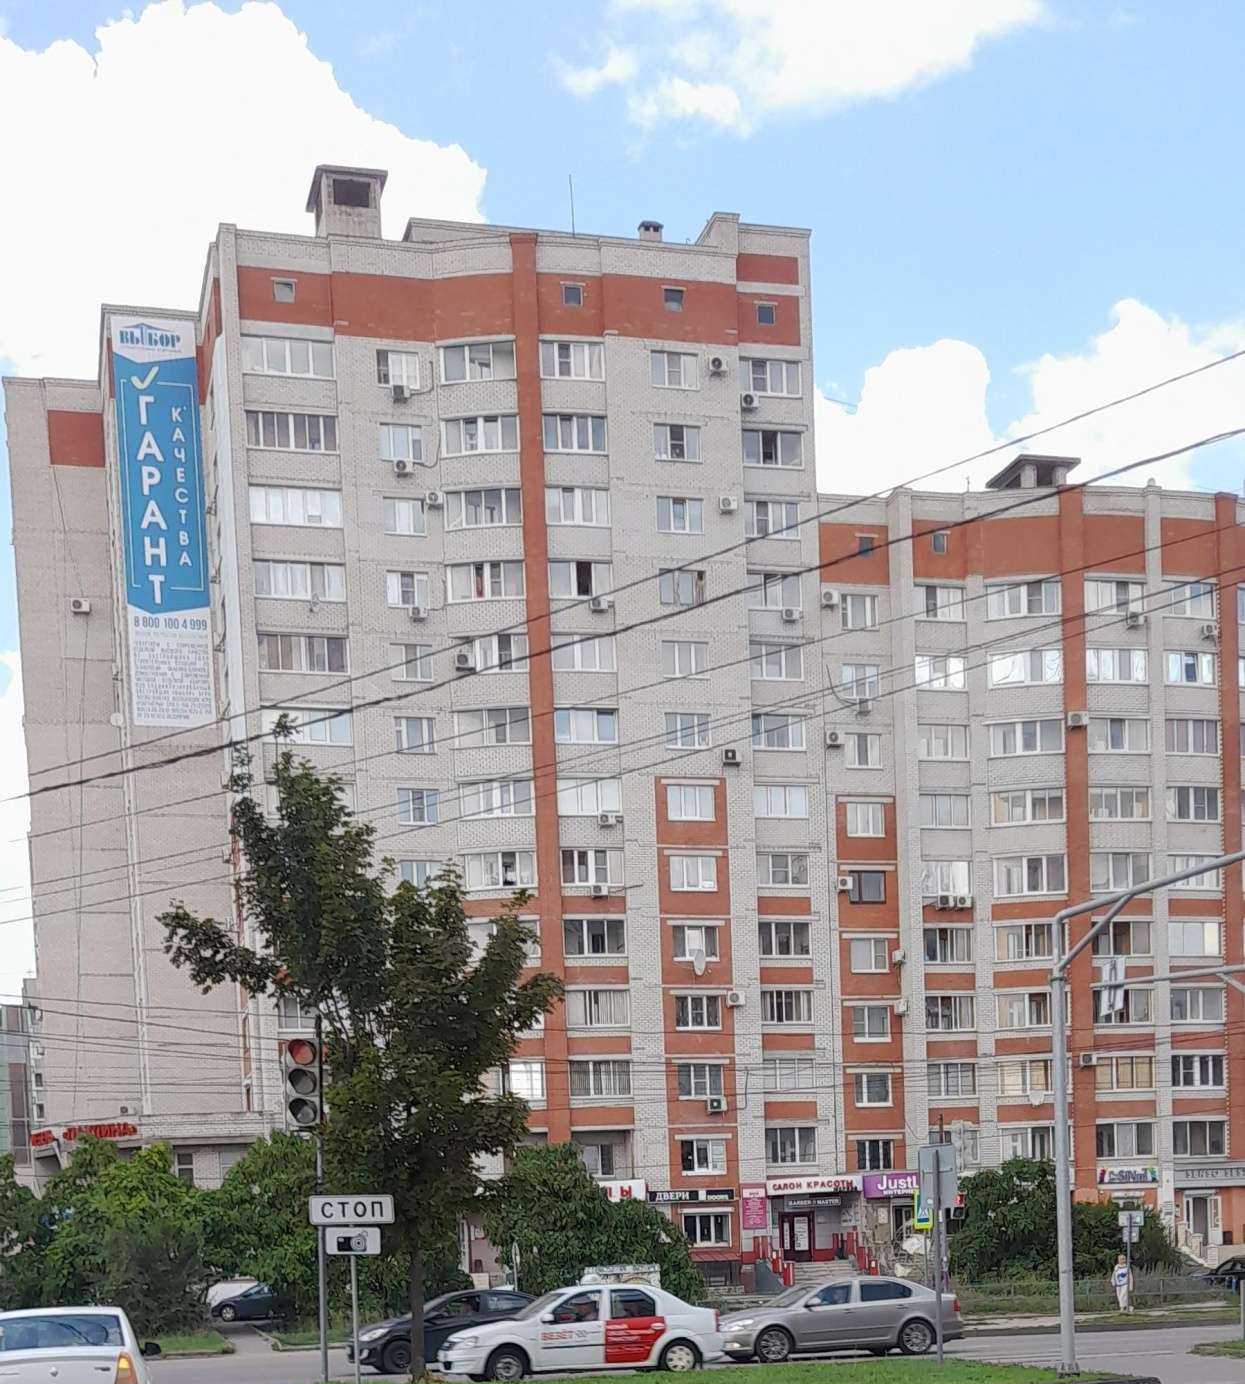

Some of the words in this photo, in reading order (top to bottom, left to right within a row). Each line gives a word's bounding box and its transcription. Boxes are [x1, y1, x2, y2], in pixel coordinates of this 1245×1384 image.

[118, 325, 181, 348] ВЫБОР
[171, 405, 192, 567] КАЧЕСТВА
[136, 395, 168, 604] ГАРАНТ
[134, 616, 140, 628] 8
[142, 616, 160, 629] 800
[164, 618, 180, 630] 100
[182, 619, 188, 630] 4
[190, 619, 207, 631] 999
[772, 1182, 802, 1191] САЛОН
[656, 1191, 690, 1201] ДВЕРИ
[321, 1201, 383, 1218] СТОП
